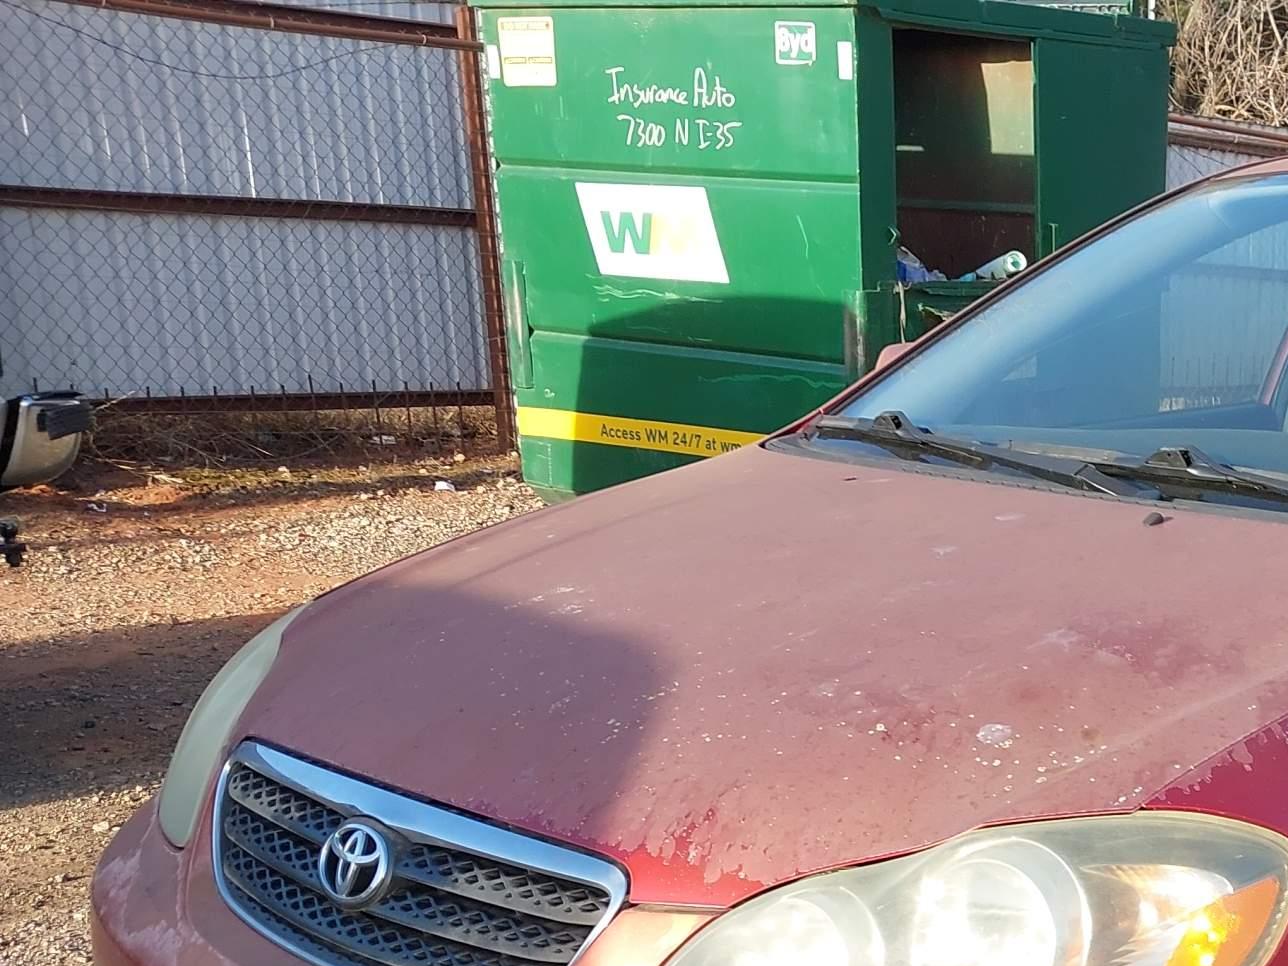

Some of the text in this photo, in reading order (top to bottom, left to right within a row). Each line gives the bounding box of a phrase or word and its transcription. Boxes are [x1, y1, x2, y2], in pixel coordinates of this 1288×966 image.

[605, 66, 736, 108] Insurance Auto
[616, 114, 742, 150] 7300 N I-35
[600, 211, 700, 256] WM
[600, 424, 641, 441] Access
[644, 428, 668, 445] WM
[672, 432, 702, 447] 24/7
[705, 438, 717, 450] at
